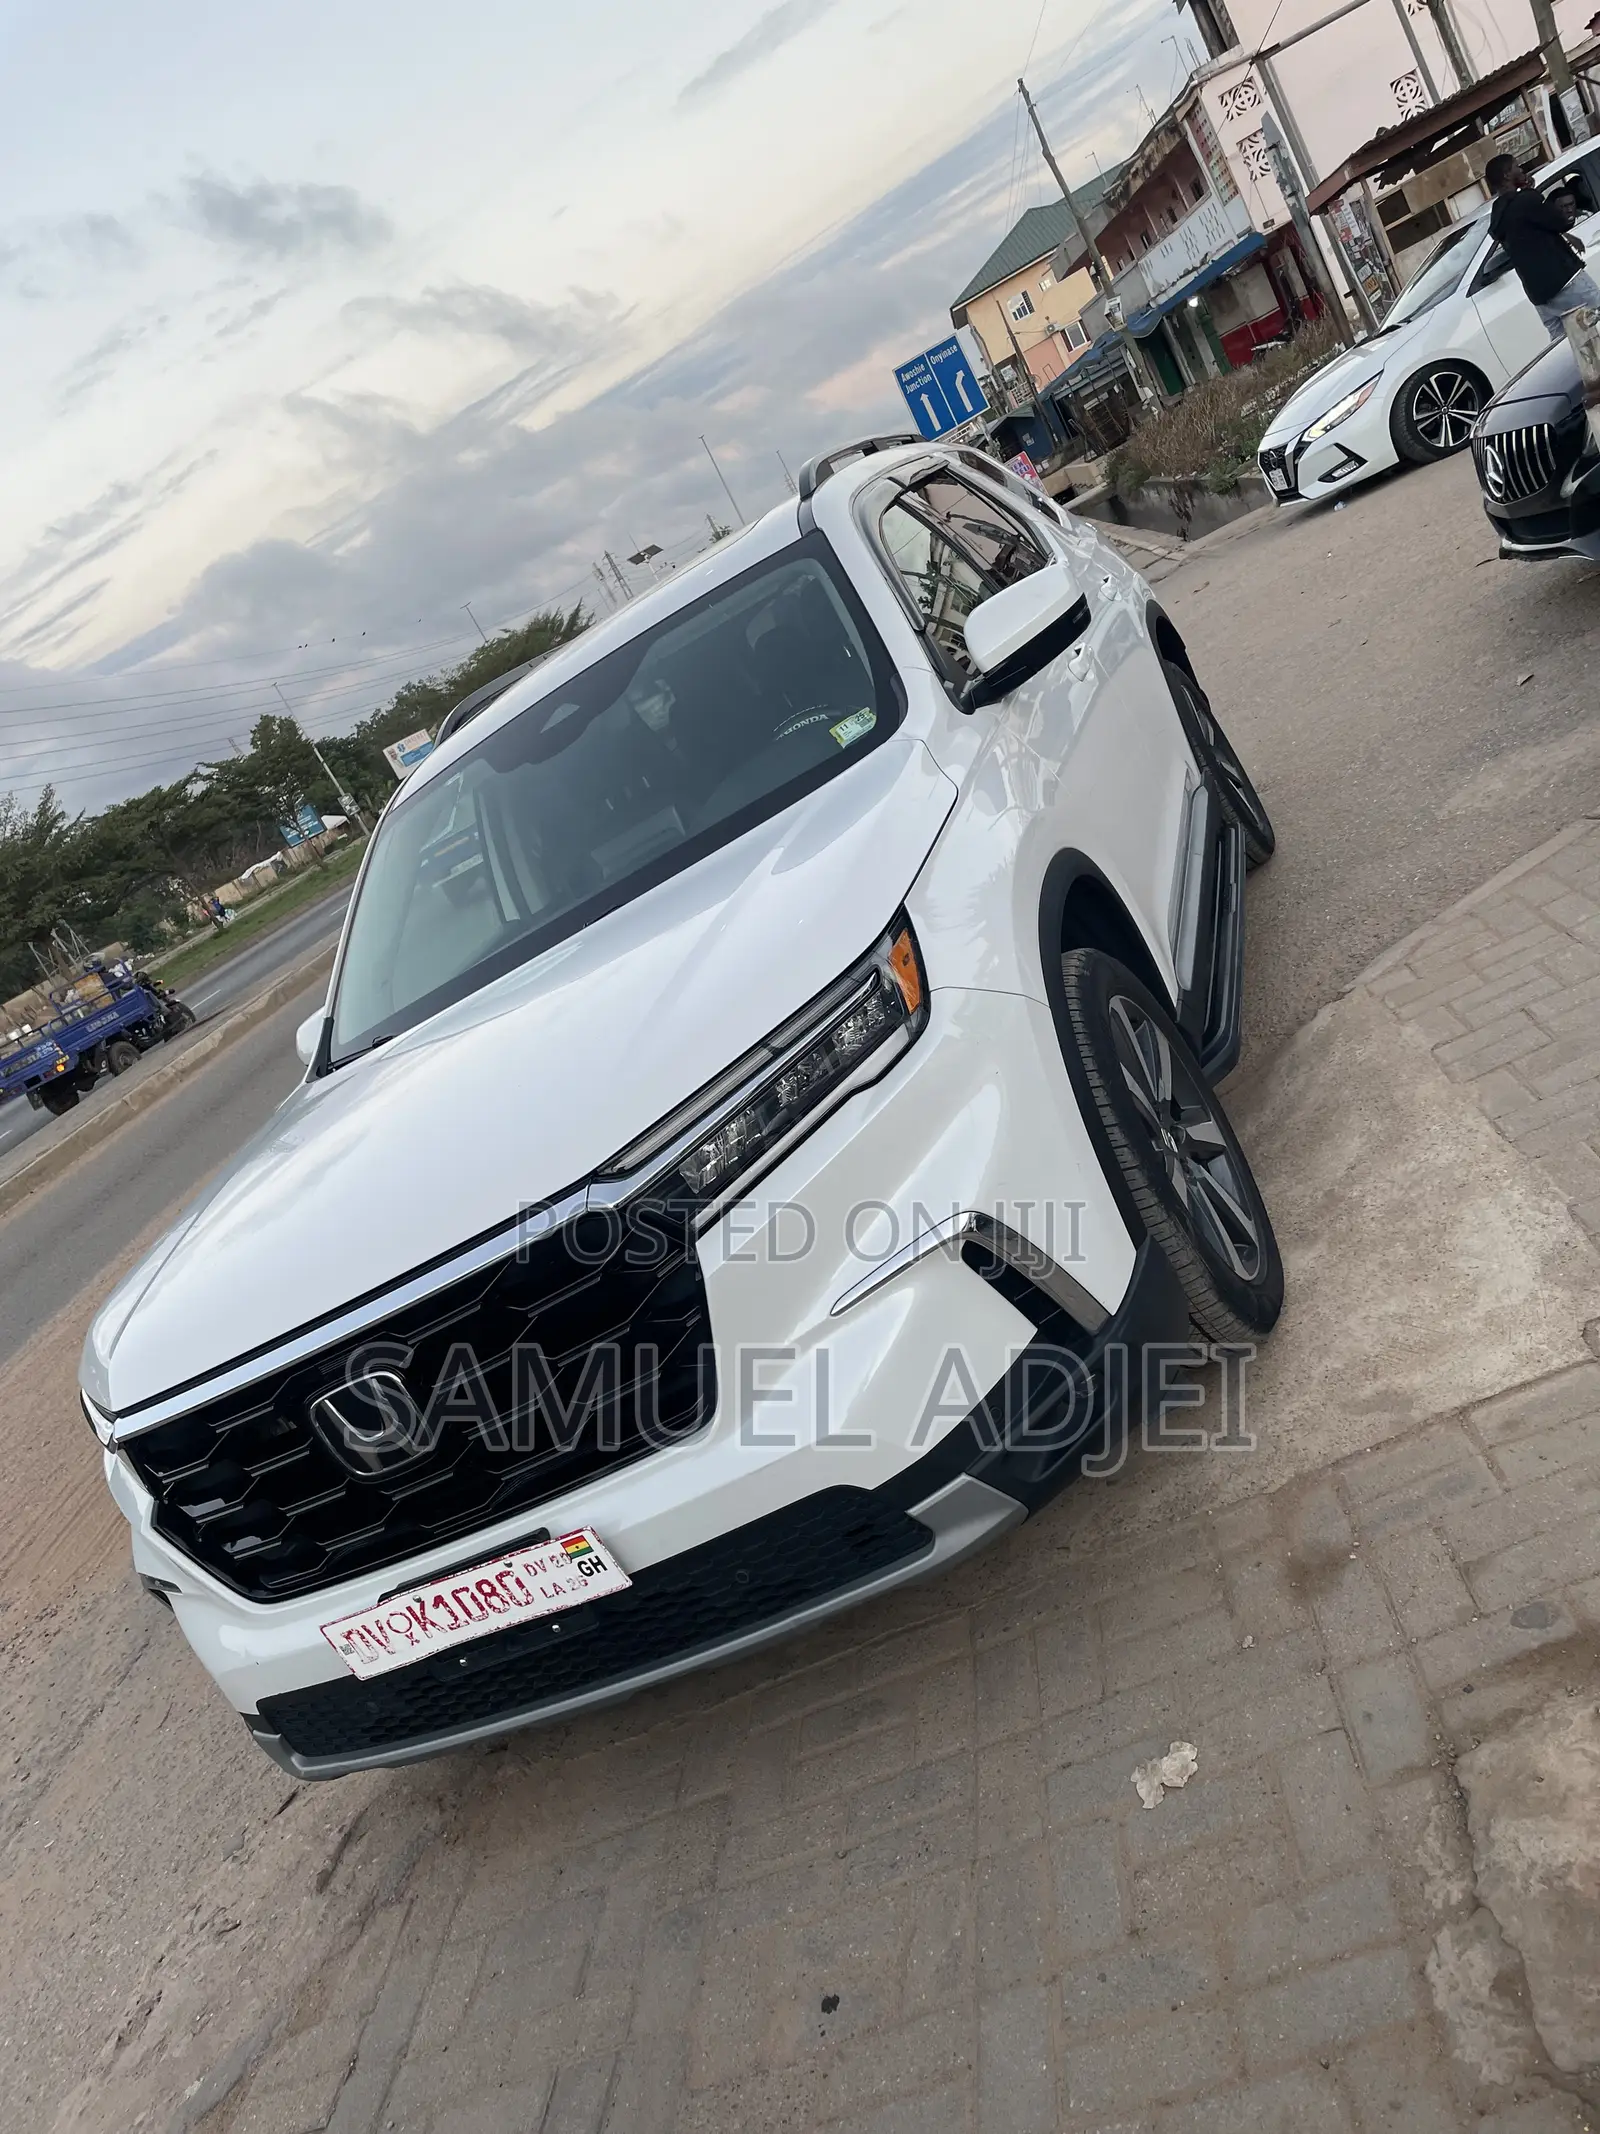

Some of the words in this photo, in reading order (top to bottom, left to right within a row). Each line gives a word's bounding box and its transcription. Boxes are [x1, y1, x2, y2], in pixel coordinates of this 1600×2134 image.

[900, 363, 926, 382] Awoshie
[905, 373, 932, 394] Junction
[578, 1556, 608, 1577] GH
[540, 1583, 565, 1599] LA
